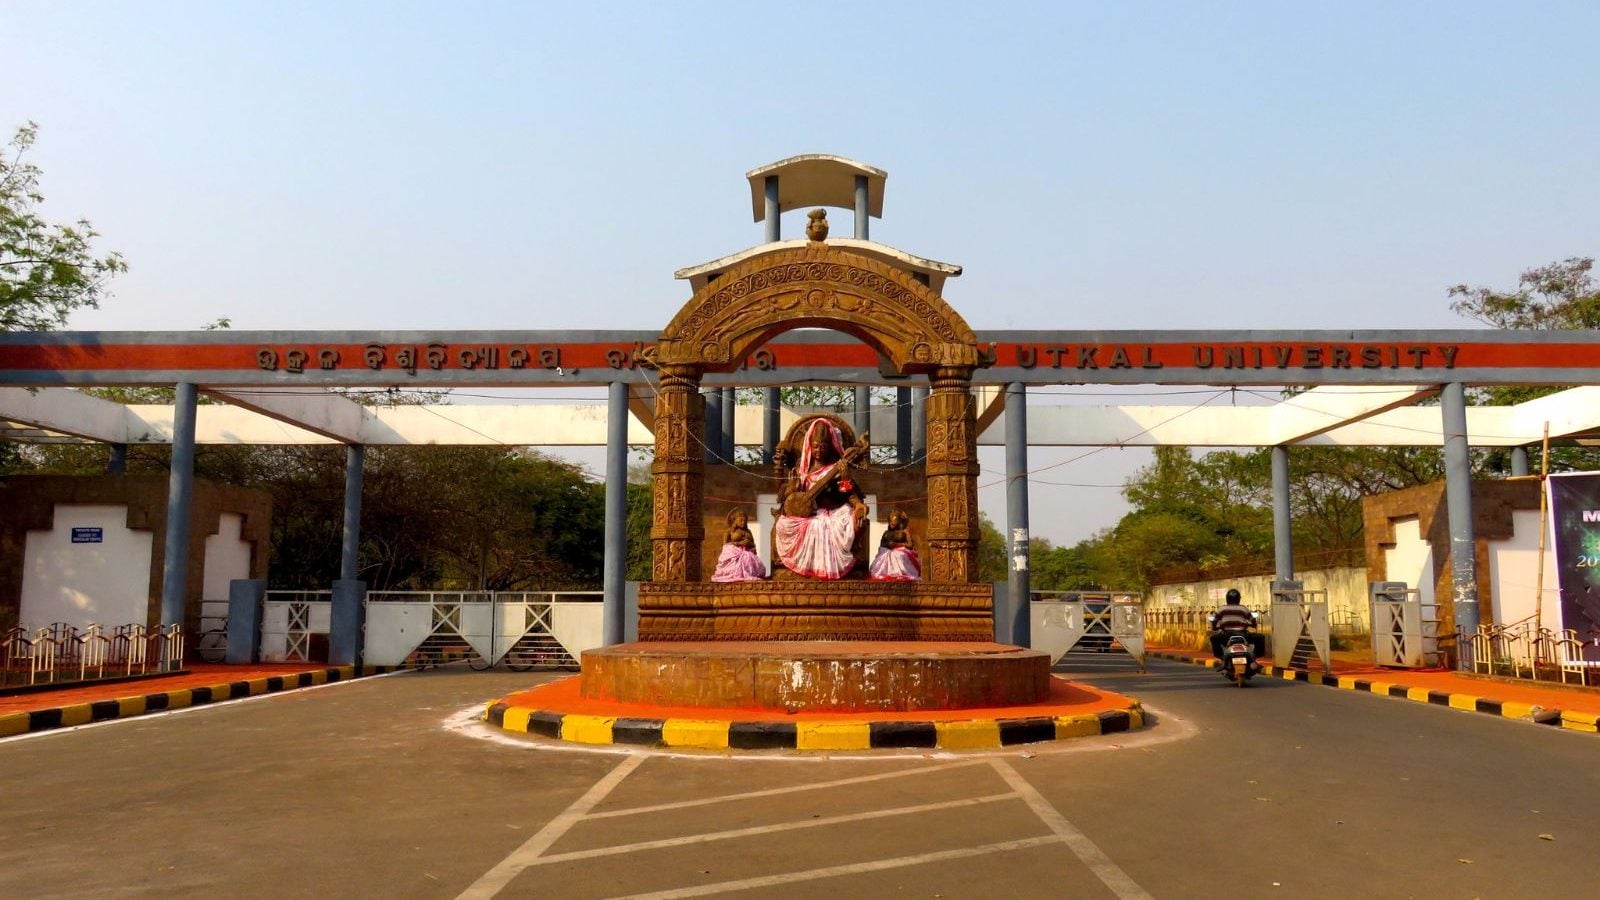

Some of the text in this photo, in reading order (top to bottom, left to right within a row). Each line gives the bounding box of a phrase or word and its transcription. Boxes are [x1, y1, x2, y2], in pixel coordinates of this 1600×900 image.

[1016, 345, 1459, 369] UTKAL UNIVERSITY
[1576, 555, 1600, 567] 20
